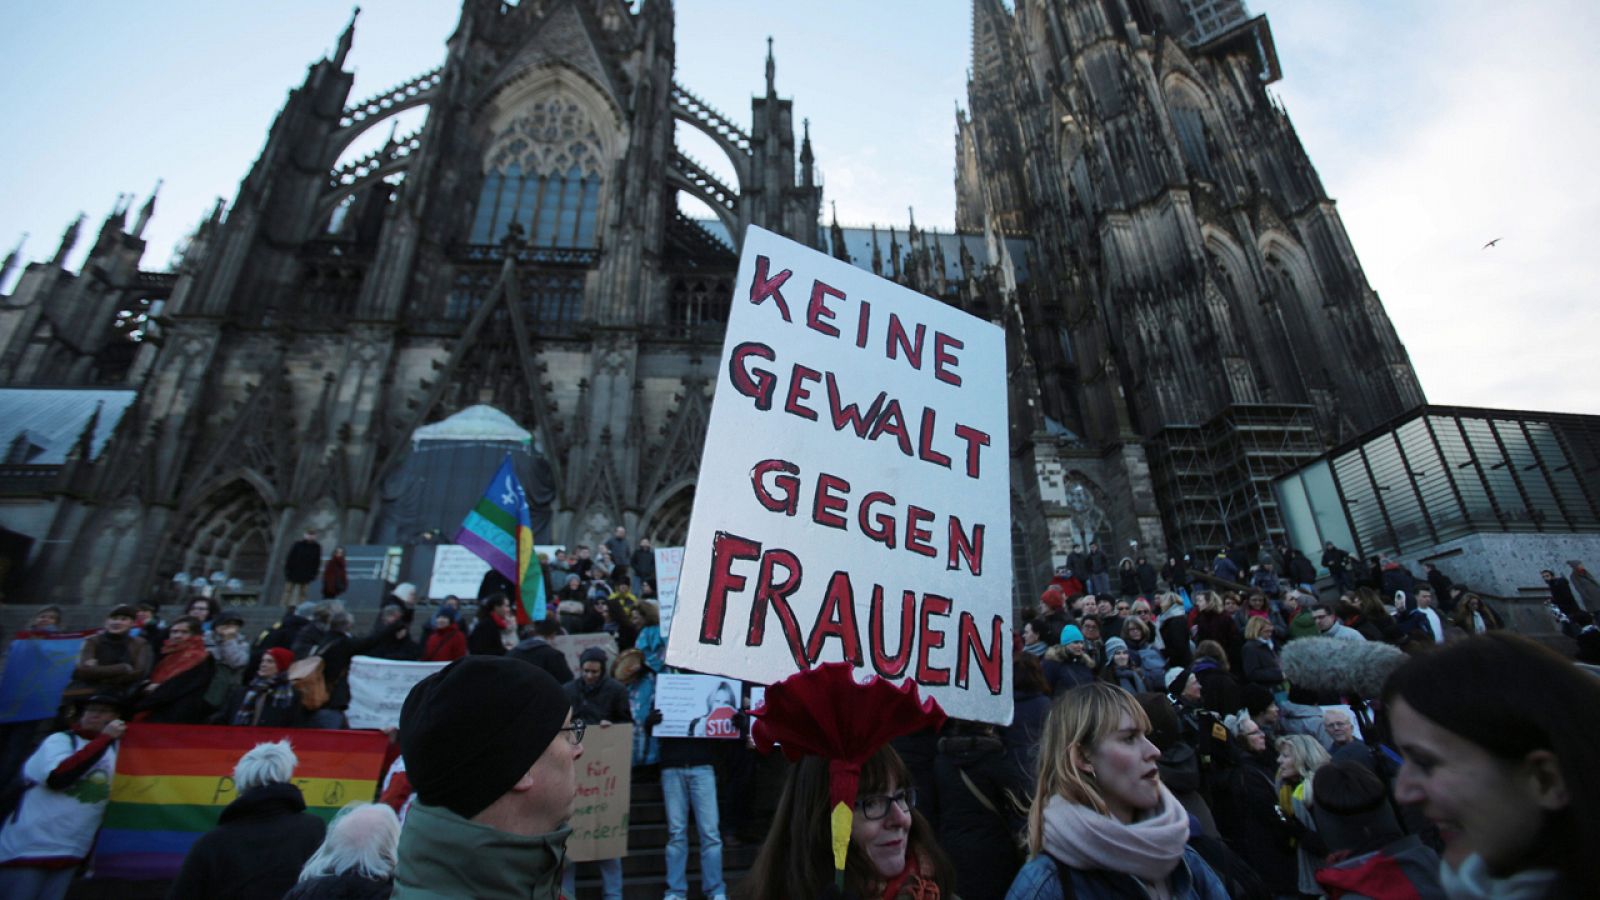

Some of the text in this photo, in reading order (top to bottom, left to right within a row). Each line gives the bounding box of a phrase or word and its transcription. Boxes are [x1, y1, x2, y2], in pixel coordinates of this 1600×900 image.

[750, 255, 965, 387] KEINE
[729, 342, 991, 479] GEWALT
[751, 459, 986, 577] GEGEN
[699, 531, 1004, 696] FRAUEN
[707, 719, 736, 736] STO
